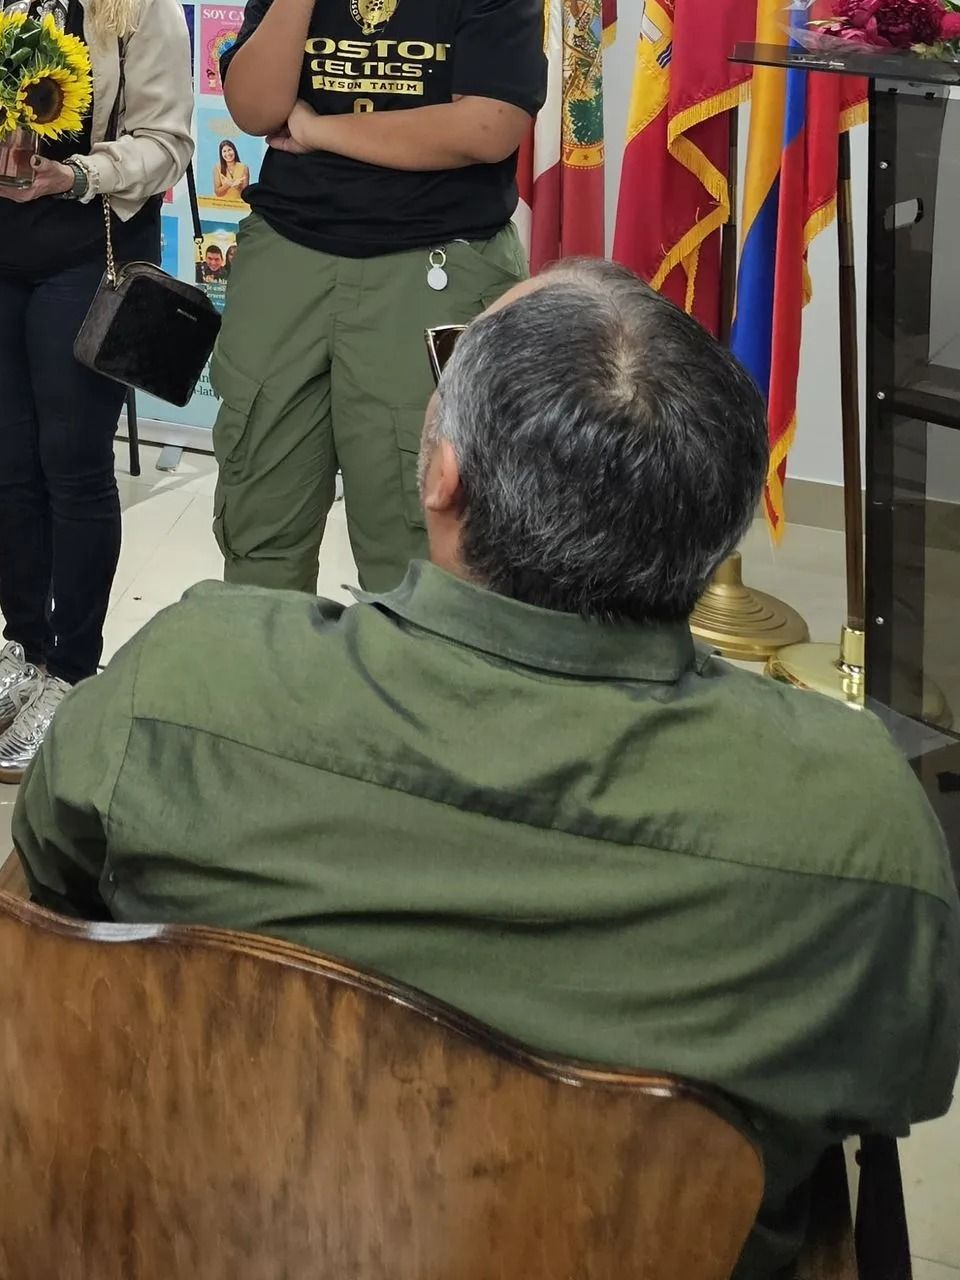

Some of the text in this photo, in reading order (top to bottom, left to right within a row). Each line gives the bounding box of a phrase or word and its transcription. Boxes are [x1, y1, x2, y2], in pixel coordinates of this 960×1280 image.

[203, 8, 227, 20] SOY
[311, 59, 423, 77] CELTICS
[370, 82, 417, 91] TATUM
